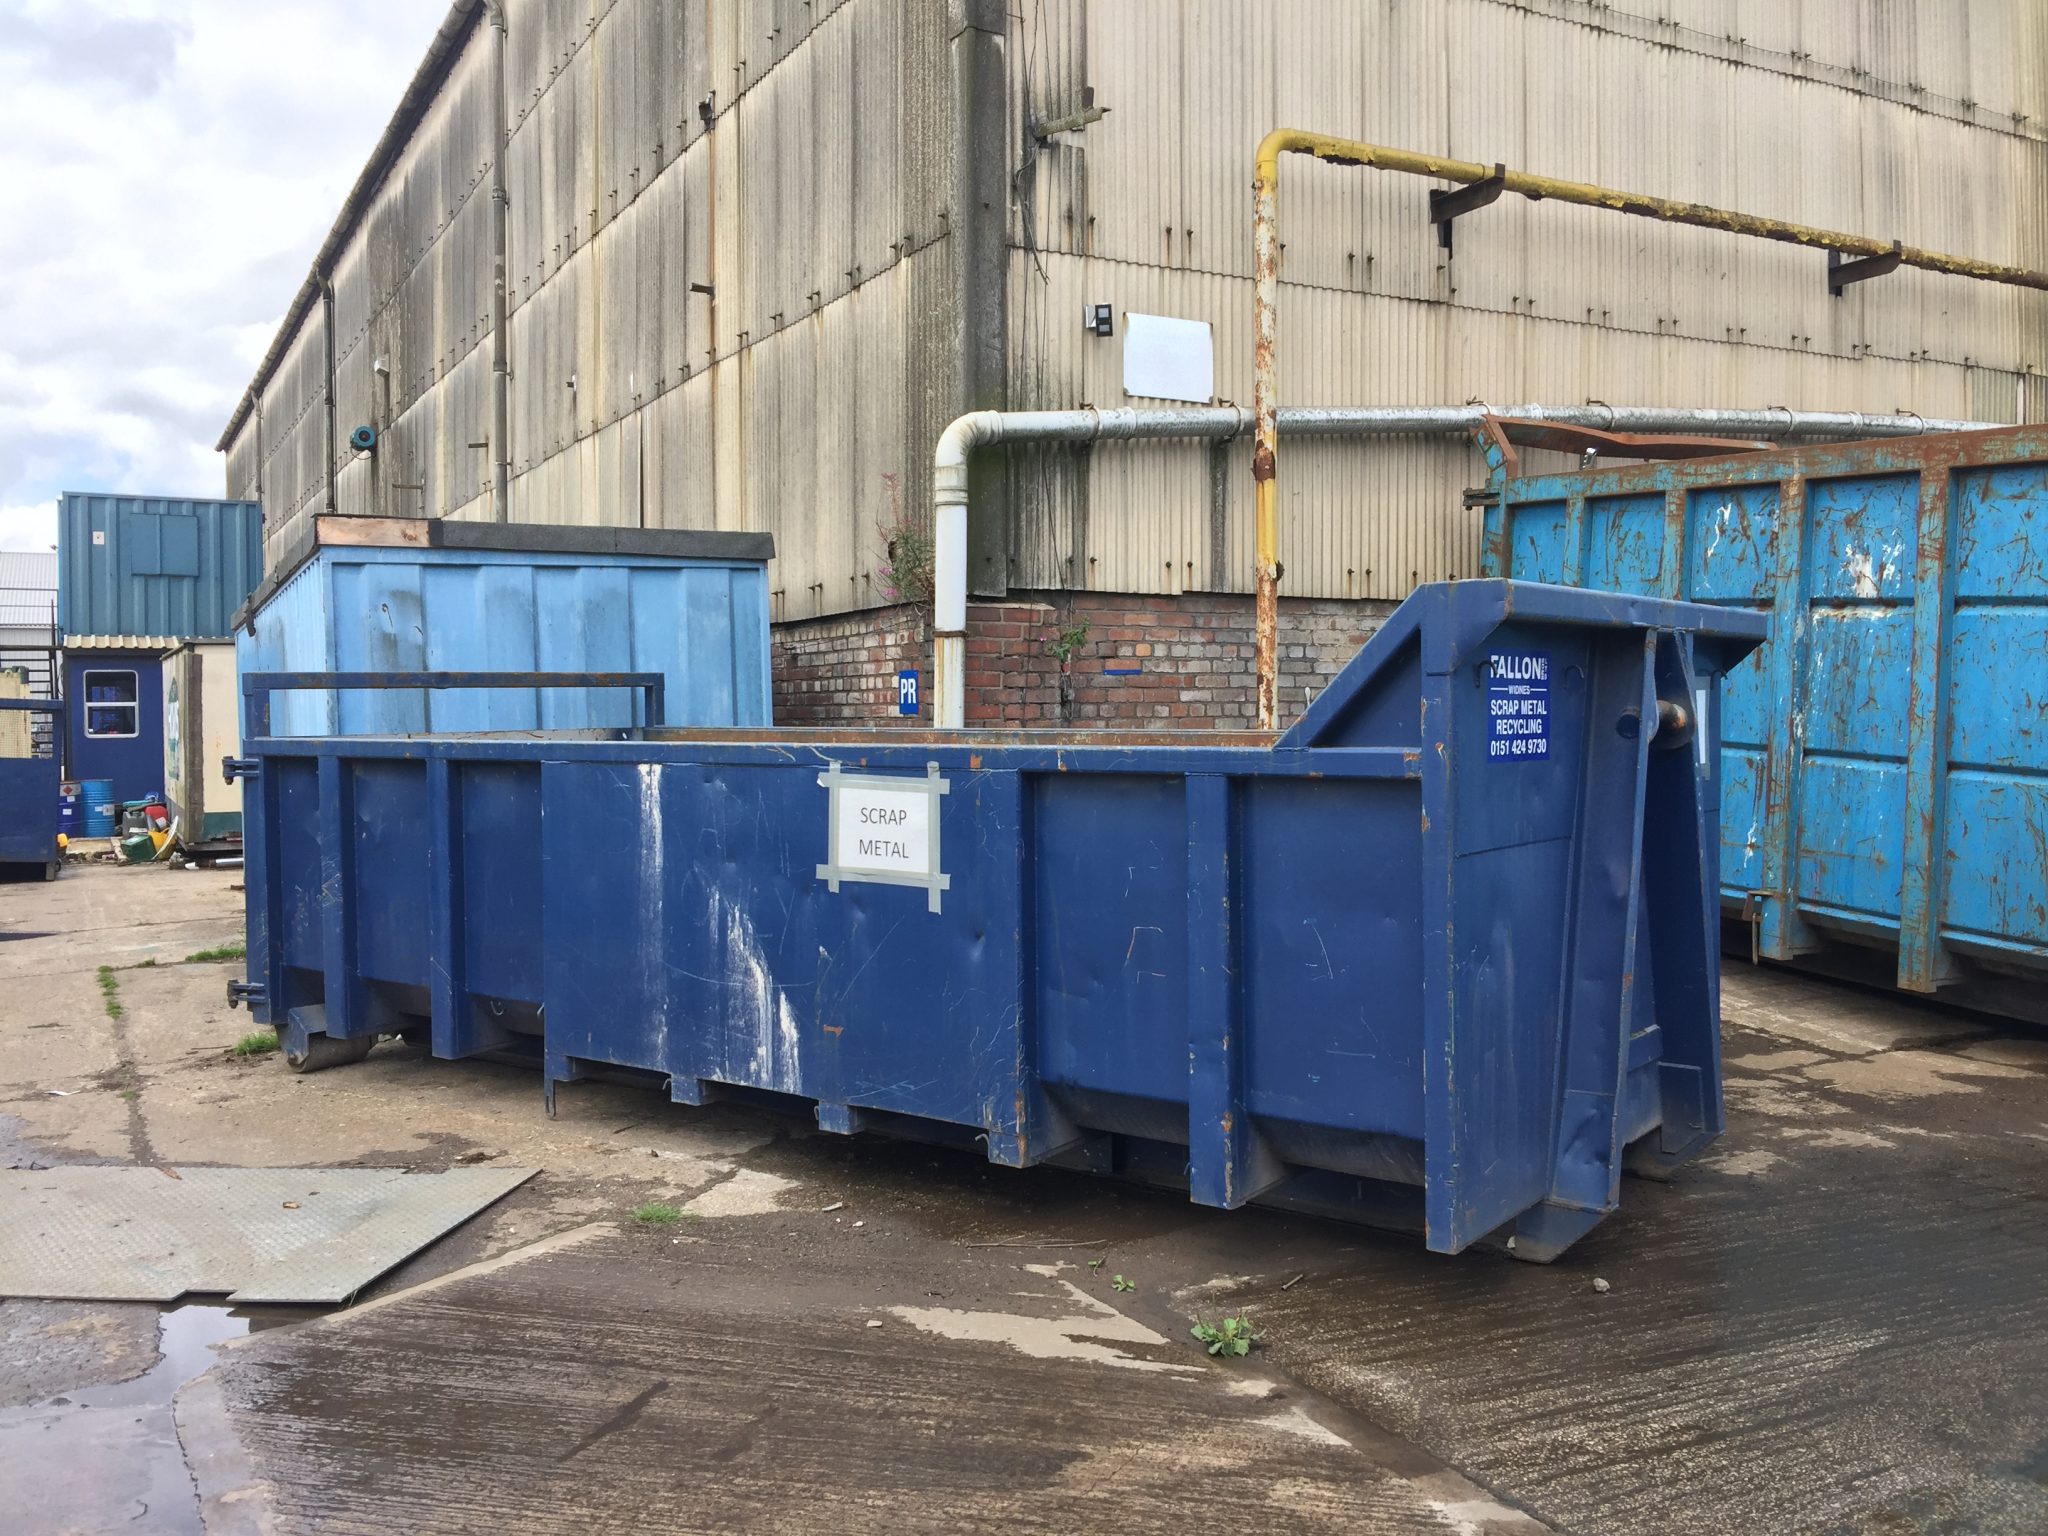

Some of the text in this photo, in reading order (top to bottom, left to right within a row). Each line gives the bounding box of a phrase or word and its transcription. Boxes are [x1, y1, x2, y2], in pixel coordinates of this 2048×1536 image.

[1490, 655, 1541, 679] FALLON
[900, 678, 917, 704] PR
[1508, 685, 1530, 695] WIDNES
[1490, 699, 1547, 715] SCRAP METAL
[1496, 718, 1542, 735] RECYCLING
[1490, 738, 1547, 756] 0151 424 9730
[860, 807, 907, 826] SCRAP
[859, 839, 909, 859] METAL
